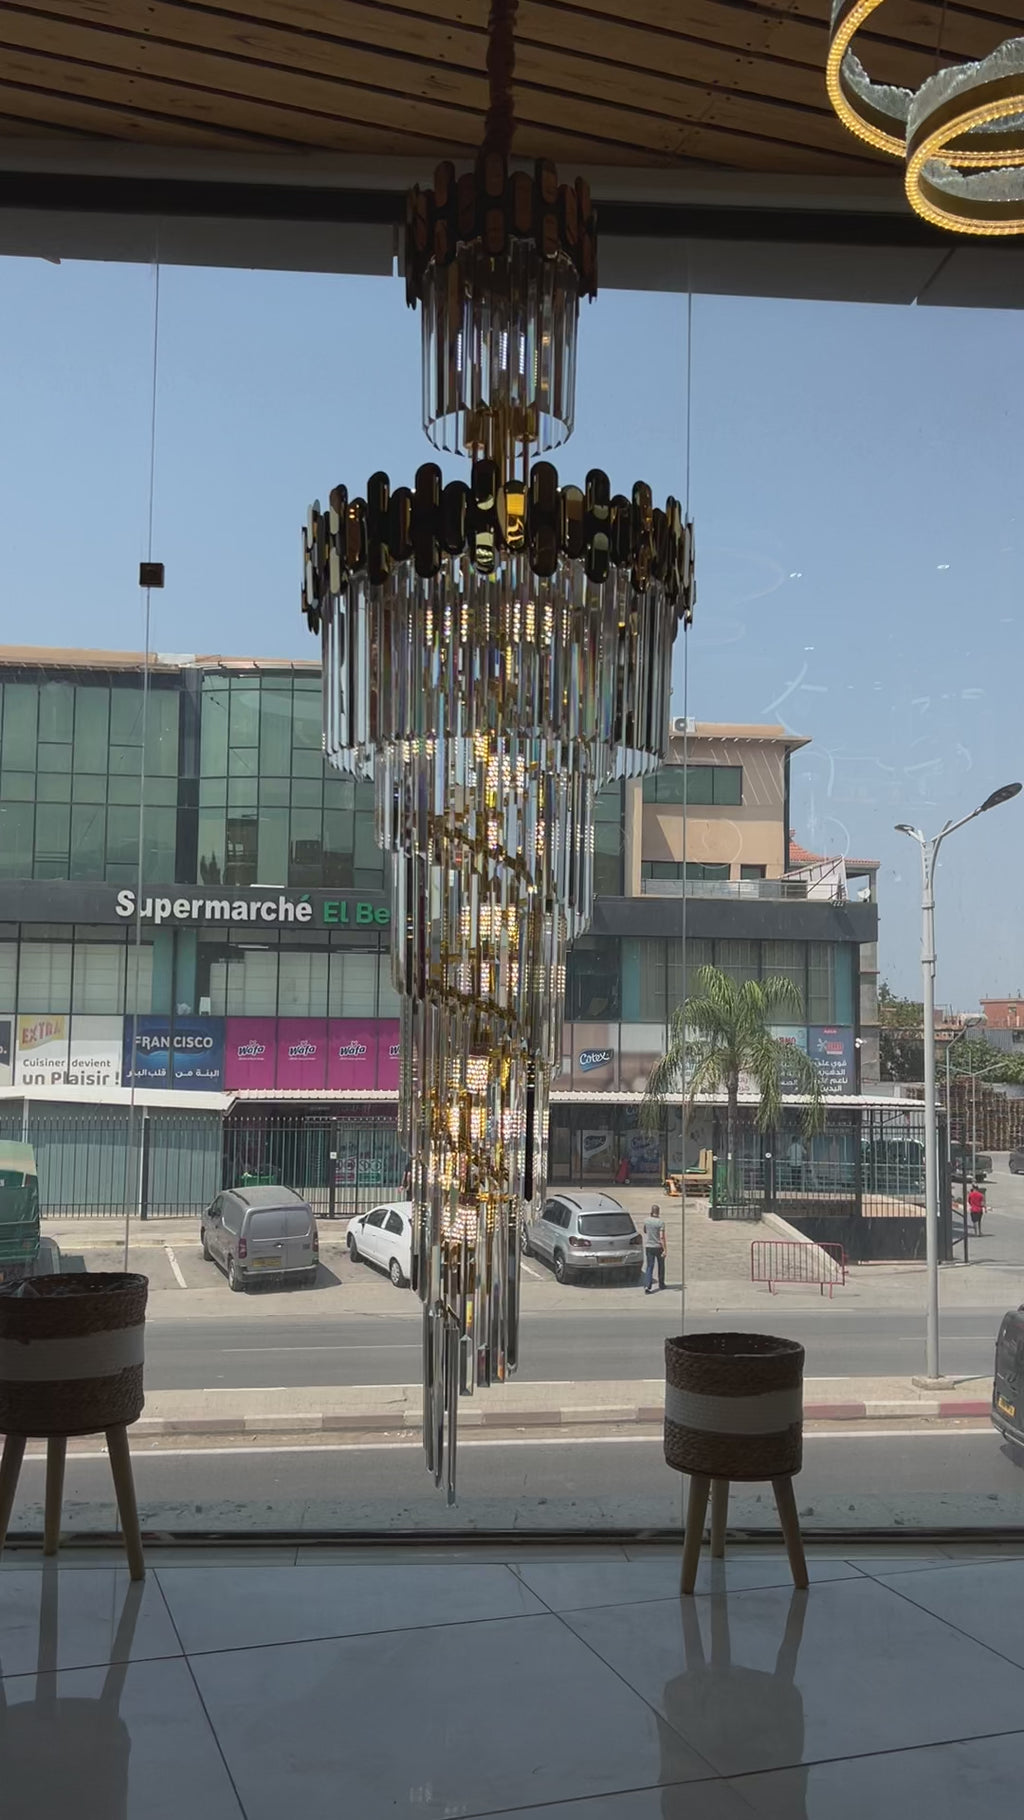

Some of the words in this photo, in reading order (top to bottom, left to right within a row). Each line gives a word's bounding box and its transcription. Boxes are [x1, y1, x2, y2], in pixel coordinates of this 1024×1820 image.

[115, 890, 313, 924] Supermarché
[322, 902, 348, 924] El
[237, 1044, 266, 1056] Wafa
[288, 1044, 317, 1056] Wafa
[339, 1044, 367, 1056] Wafa
[23, 1058, 66, 1068] Cuisiner
[71, 1059, 112, 1068] devient
[579, 1051, 611, 1065] Cotex
[22, 1074, 46, 1085] un
[51, 1070, 110, 1085] Plaisir
